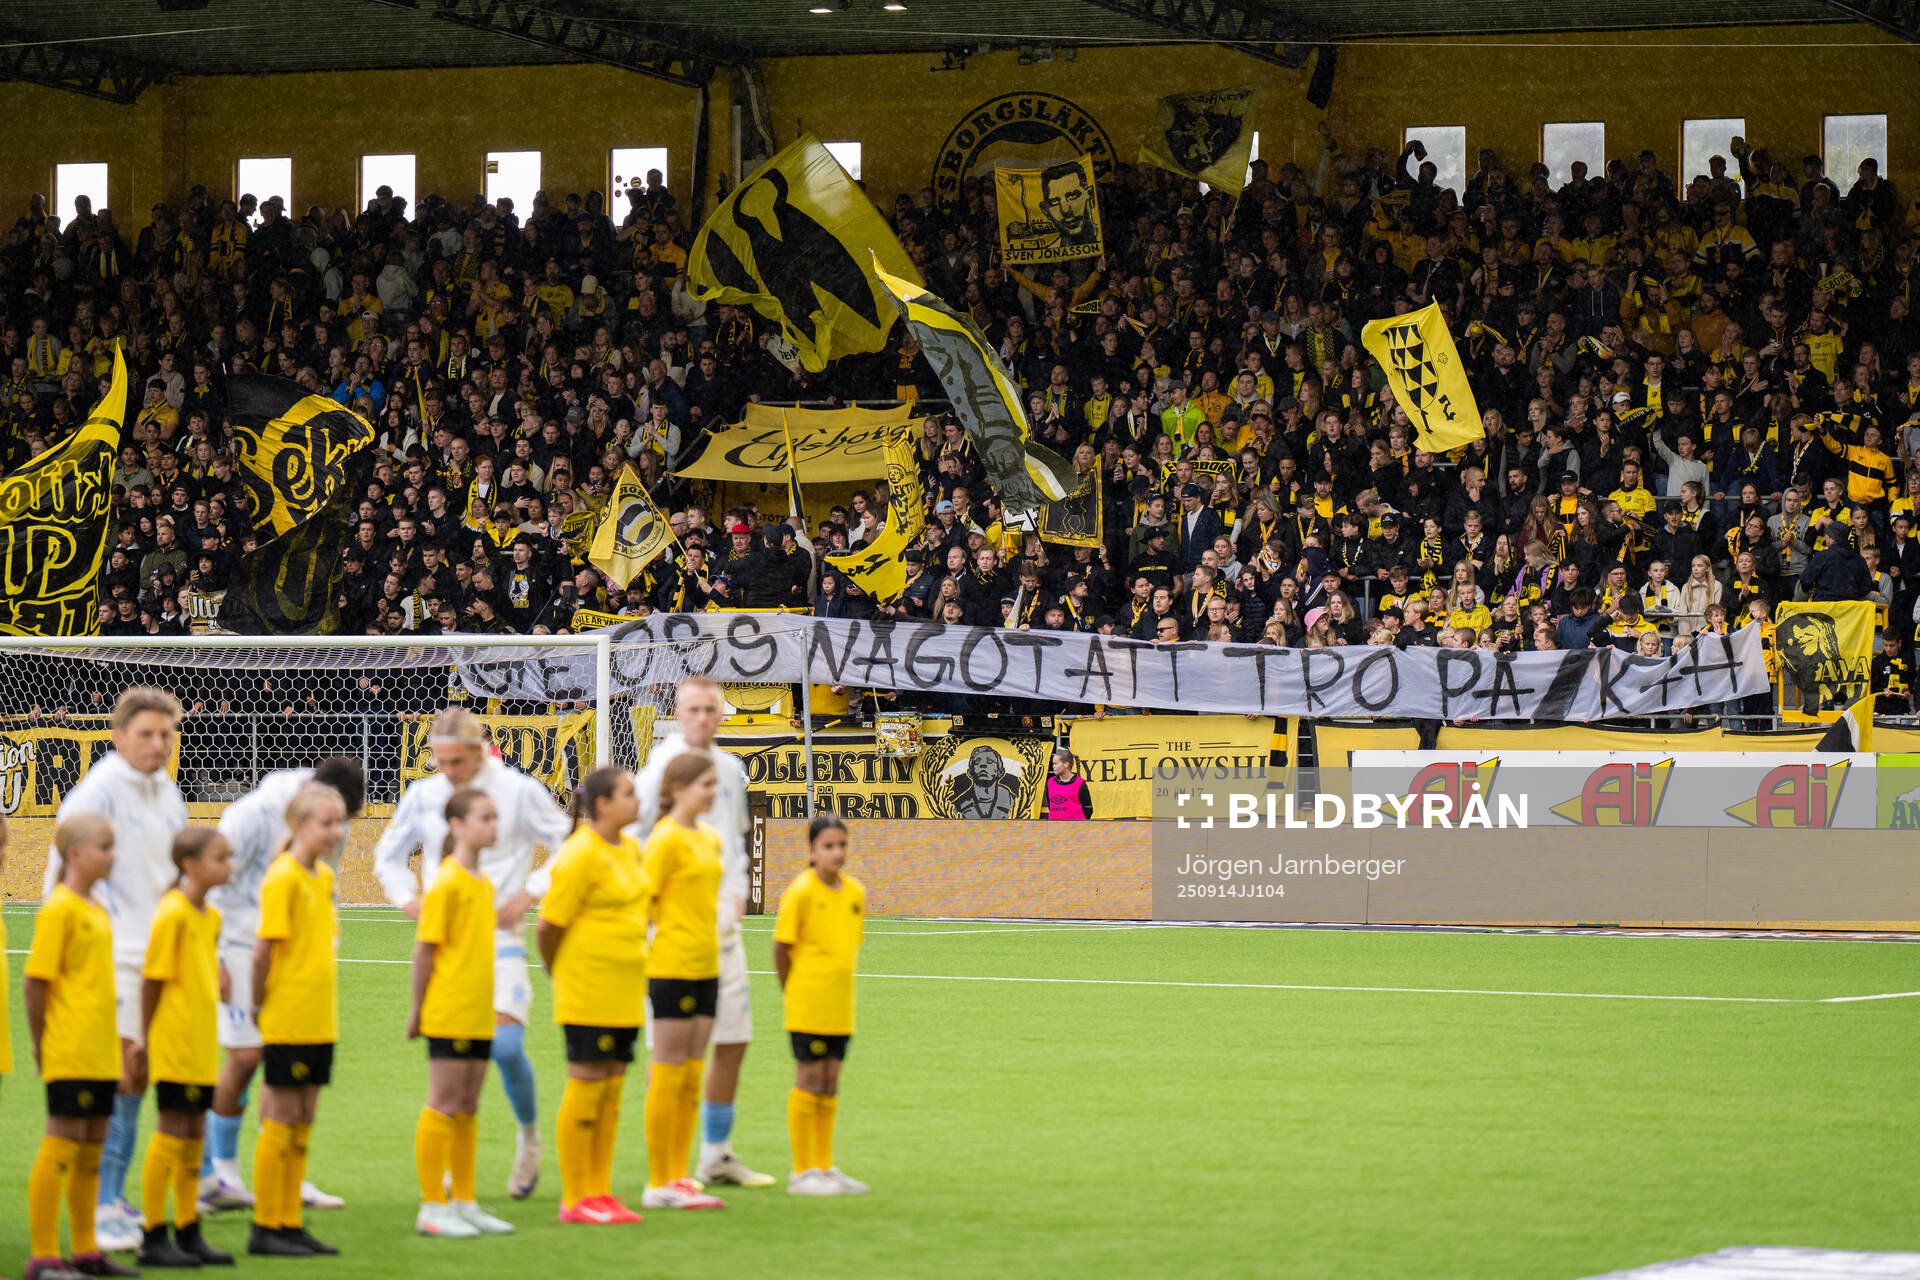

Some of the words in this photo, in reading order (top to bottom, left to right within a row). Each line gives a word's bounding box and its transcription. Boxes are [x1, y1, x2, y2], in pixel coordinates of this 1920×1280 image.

[1005, 250, 1034, 261] SVEN
[612, 615, 777, 681] OSS
[808, 615, 1063, 693] NÅGOT
[1065, 635, 1208, 702] ATT
[1222, 647, 1400, 713] TRO
[1437, 647, 1535, 718] PÅ
[1166, 741, 1192, 752] THE
[1081, 755, 1268, 783] YELLOWSHI
[752, 816, 766, 904] SELECT
